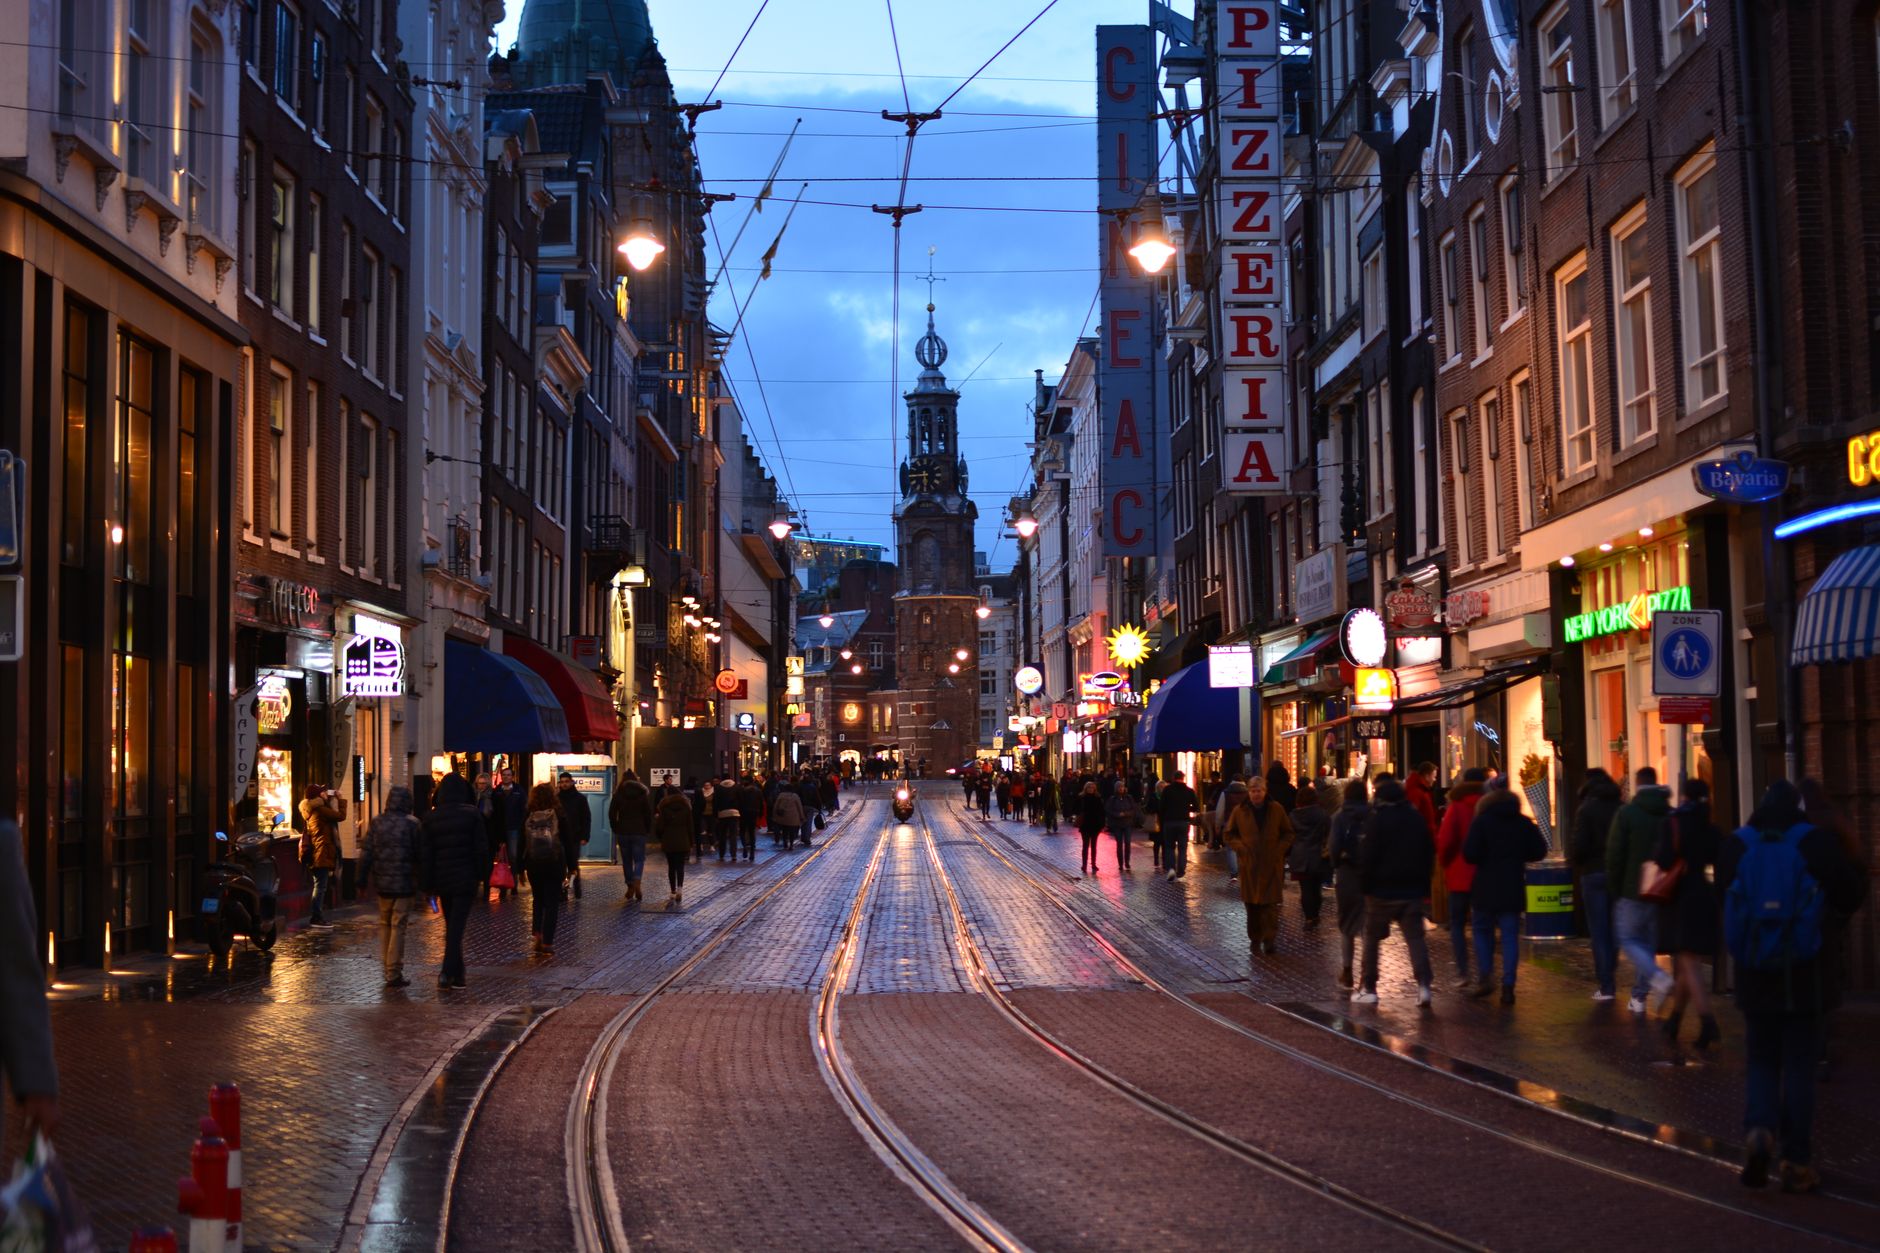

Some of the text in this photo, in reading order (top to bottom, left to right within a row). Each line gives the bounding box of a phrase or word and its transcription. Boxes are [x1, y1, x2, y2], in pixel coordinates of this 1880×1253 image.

[1226, 6, 1280, 485] PIZZERIA
[1104, 44, 1145, 548] CINEAC
[1710, 469, 1780, 488] Bavaria
[1564, 612, 1596, 643] NEW
[1647, 585, 1692, 622] PIZZA
[1671, 616, 1703, 625] ZONE
[237, 703, 247, 784] TATTOO
